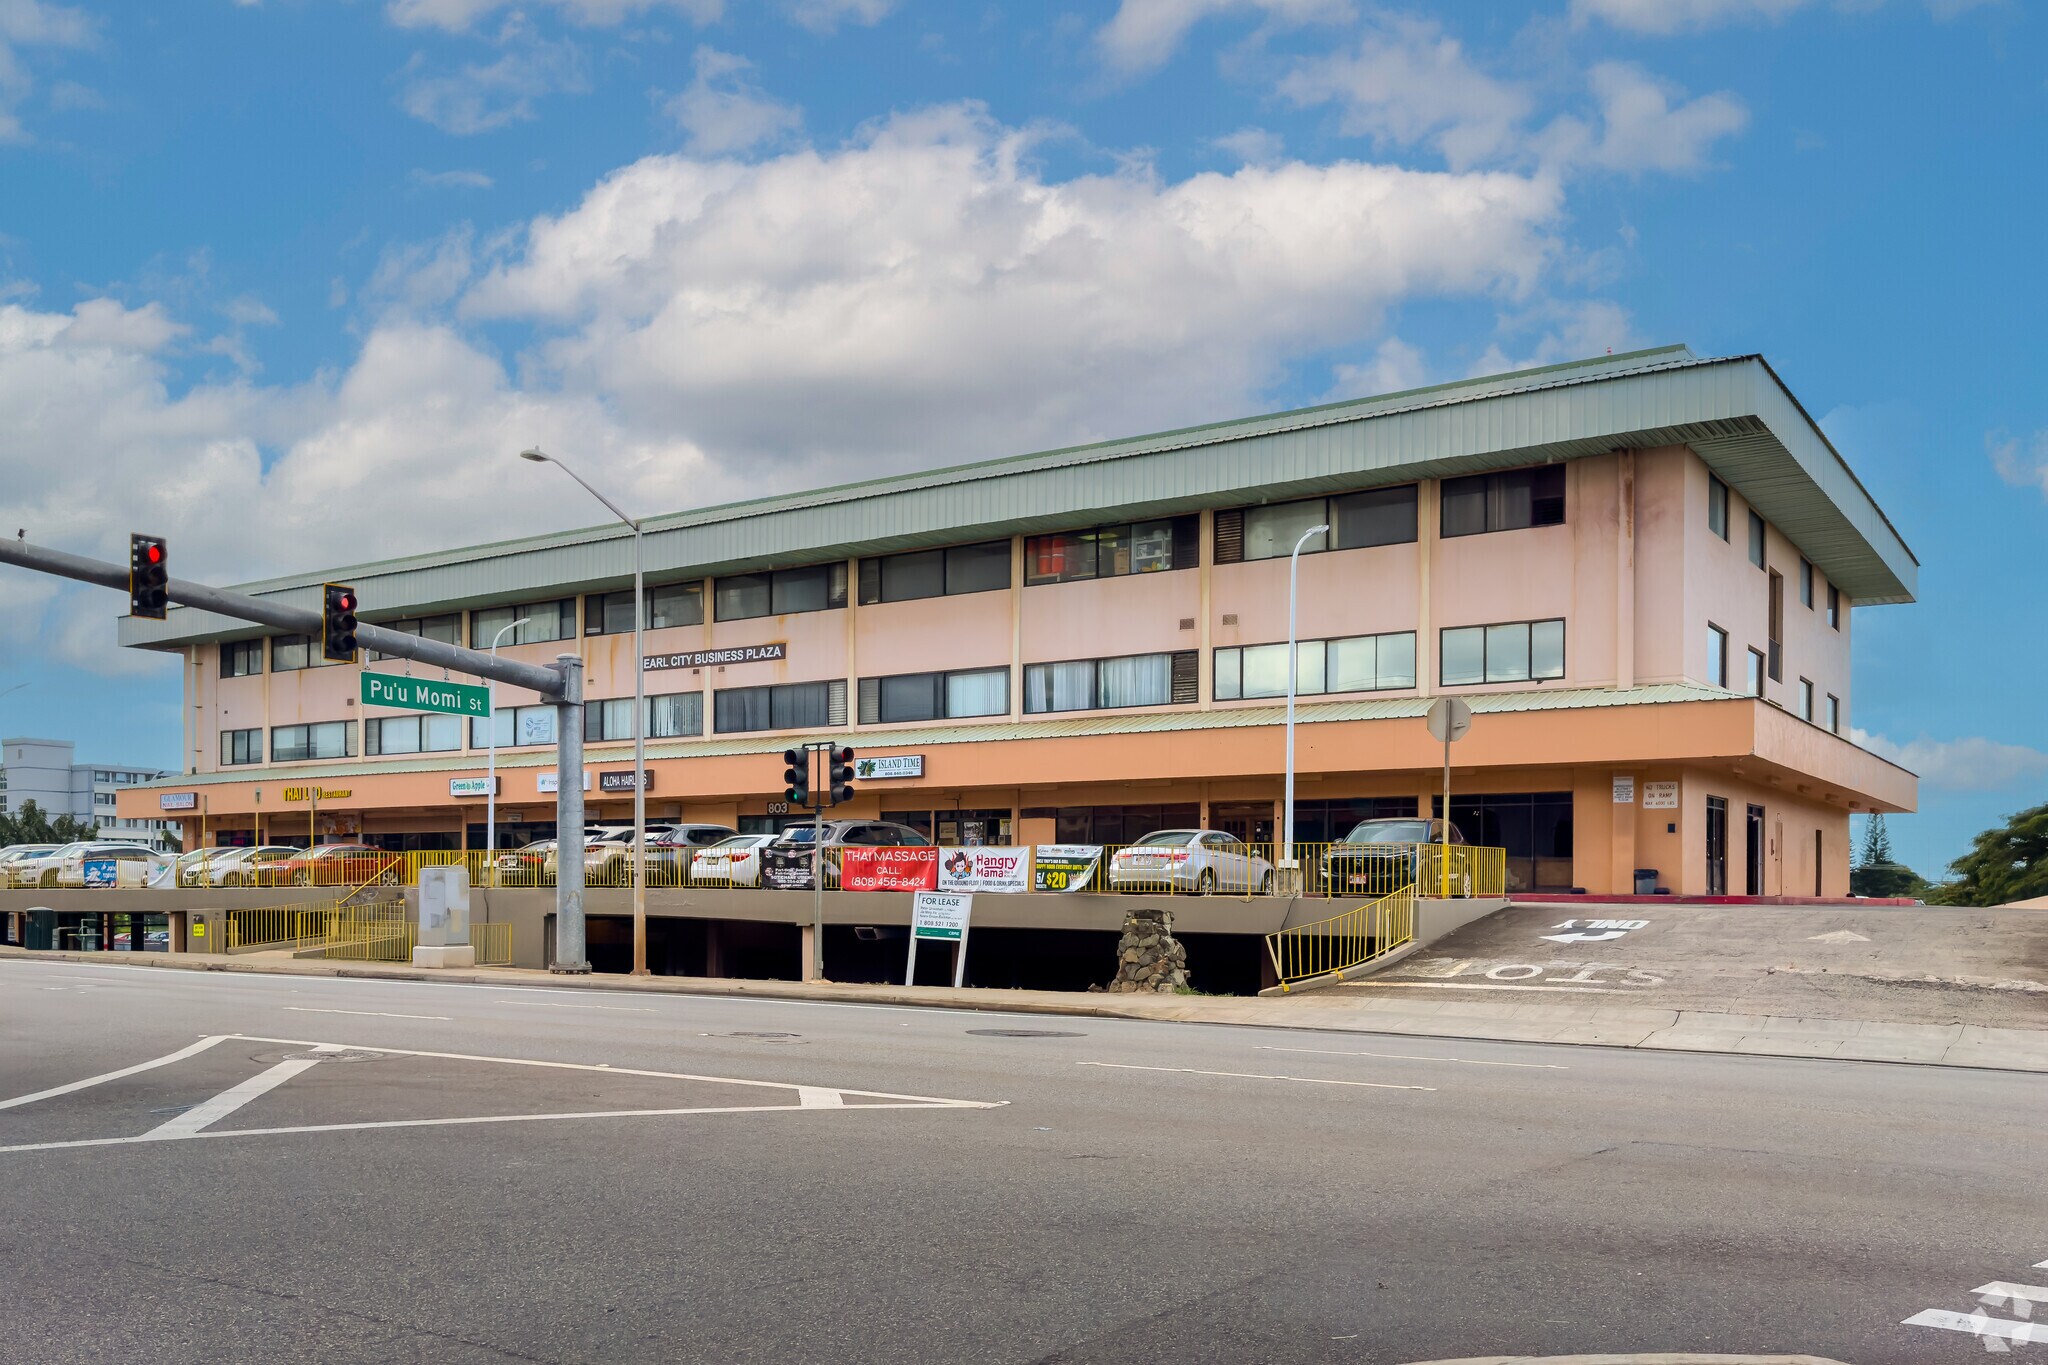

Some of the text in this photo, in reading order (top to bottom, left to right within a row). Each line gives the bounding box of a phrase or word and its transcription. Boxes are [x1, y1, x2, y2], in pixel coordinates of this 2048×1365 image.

[644, 646, 782, 669] EARL CITY BUSINESS PLAZA
[370, 680, 482, 711] Pu'u Momi St
[878, 758, 920, 769] ISLAND TIME
[452, 780, 485, 791] Green Apple
[603, 774, 647, 787] ALOHA HAIRLS
[284, 787, 303, 801] THAI
[304, 786, 322, 800] LO
[768, 803, 788, 813] 803
[846, 850, 936, 862] THAI MASSAGE
[976, 854, 1018, 869] Hangry
[876, 866, 902, 874] CALL:
[976, 868, 1004, 877] Mama
[852, 877, 926, 886] (808) 456-8424
[1046, 872, 1066, 888] $20
[1552, 919, 1650, 930] ONLY
